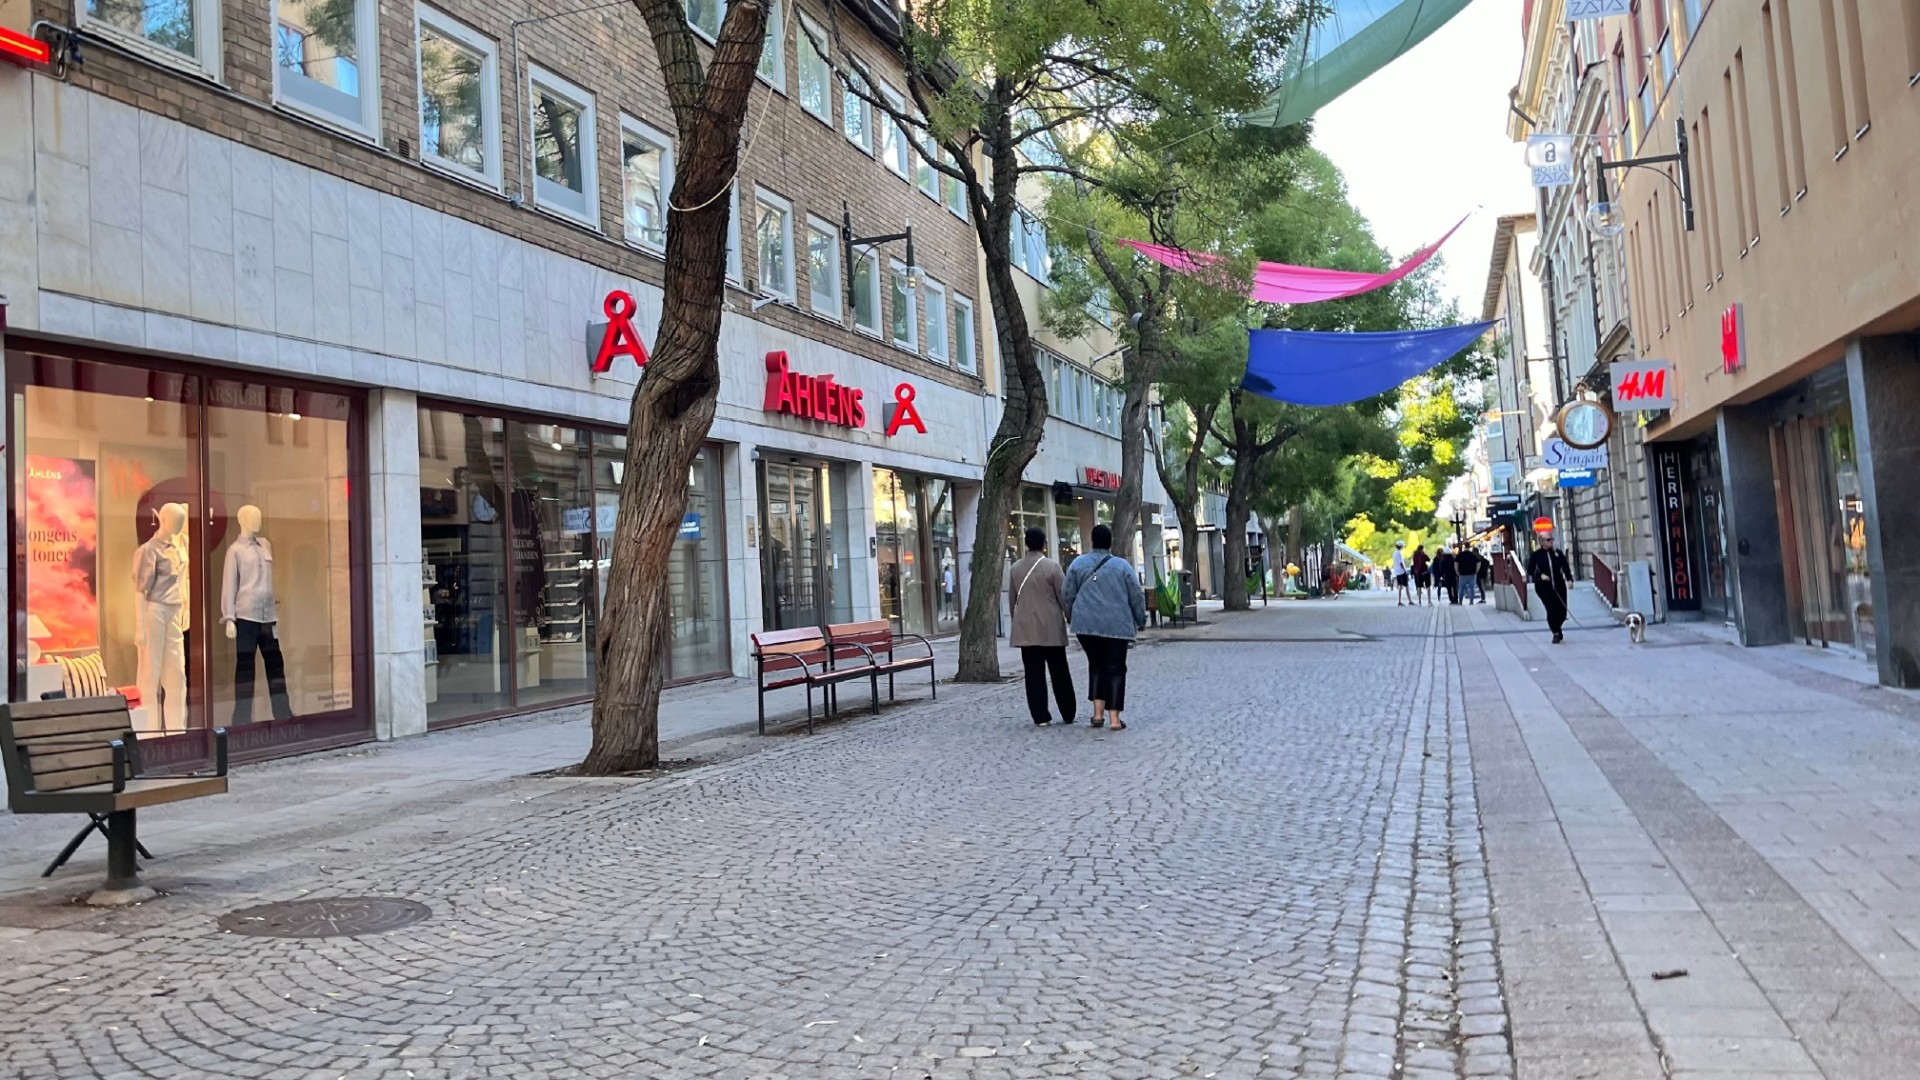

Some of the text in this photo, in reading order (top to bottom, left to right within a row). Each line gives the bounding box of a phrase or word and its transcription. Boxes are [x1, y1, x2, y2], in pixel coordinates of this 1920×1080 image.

[592, 289, 652, 373] Å
[764, 350, 866, 429] ÅHLÉNS
[1617, 368, 1666, 401] H&M
[885, 382, 929, 437] Å
[1560, 470, 1591, 479] Company
[32, 549, 71, 562] toner
